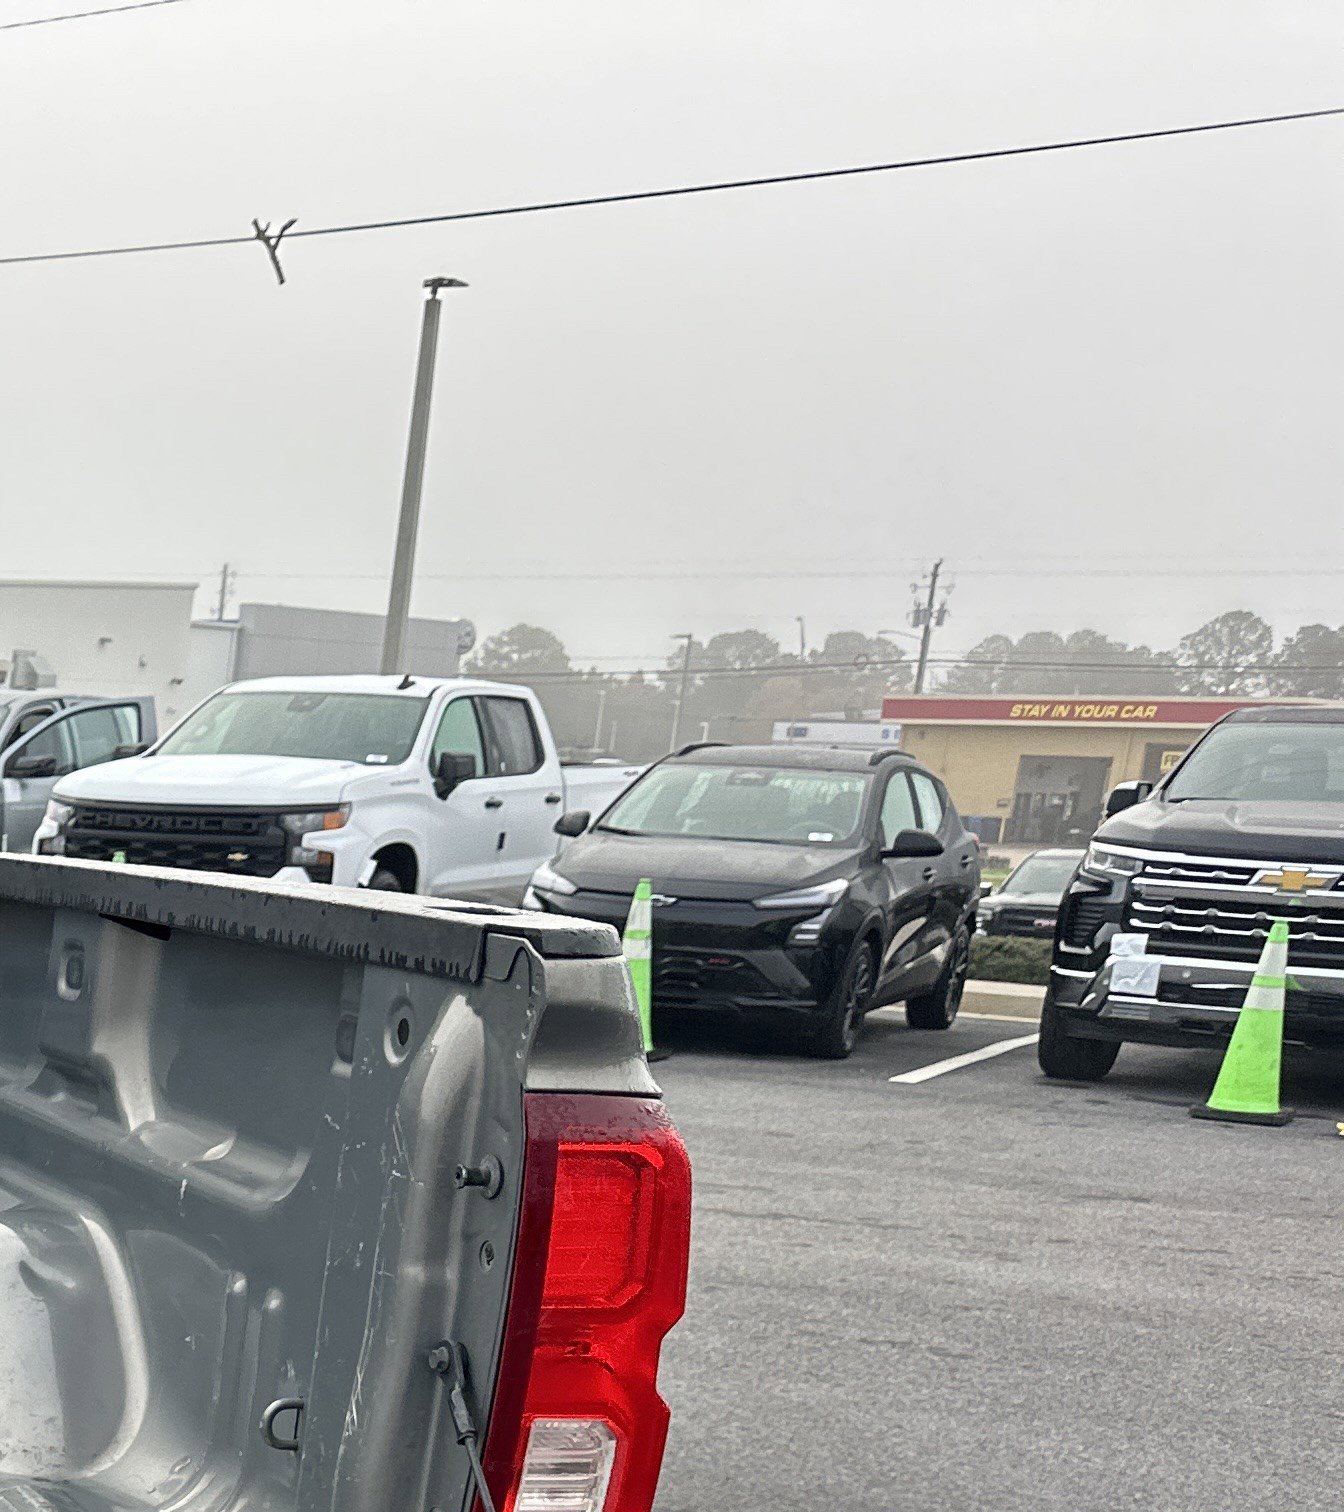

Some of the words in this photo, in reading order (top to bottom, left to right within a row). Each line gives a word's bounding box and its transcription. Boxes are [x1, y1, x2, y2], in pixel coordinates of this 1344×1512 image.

[1010, 704, 1050, 717] STAY
[1051, 705, 1071, 717] IN
[1074, 705, 1119, 718] YOUR
[1120, 705, 1158, 718] CAR
